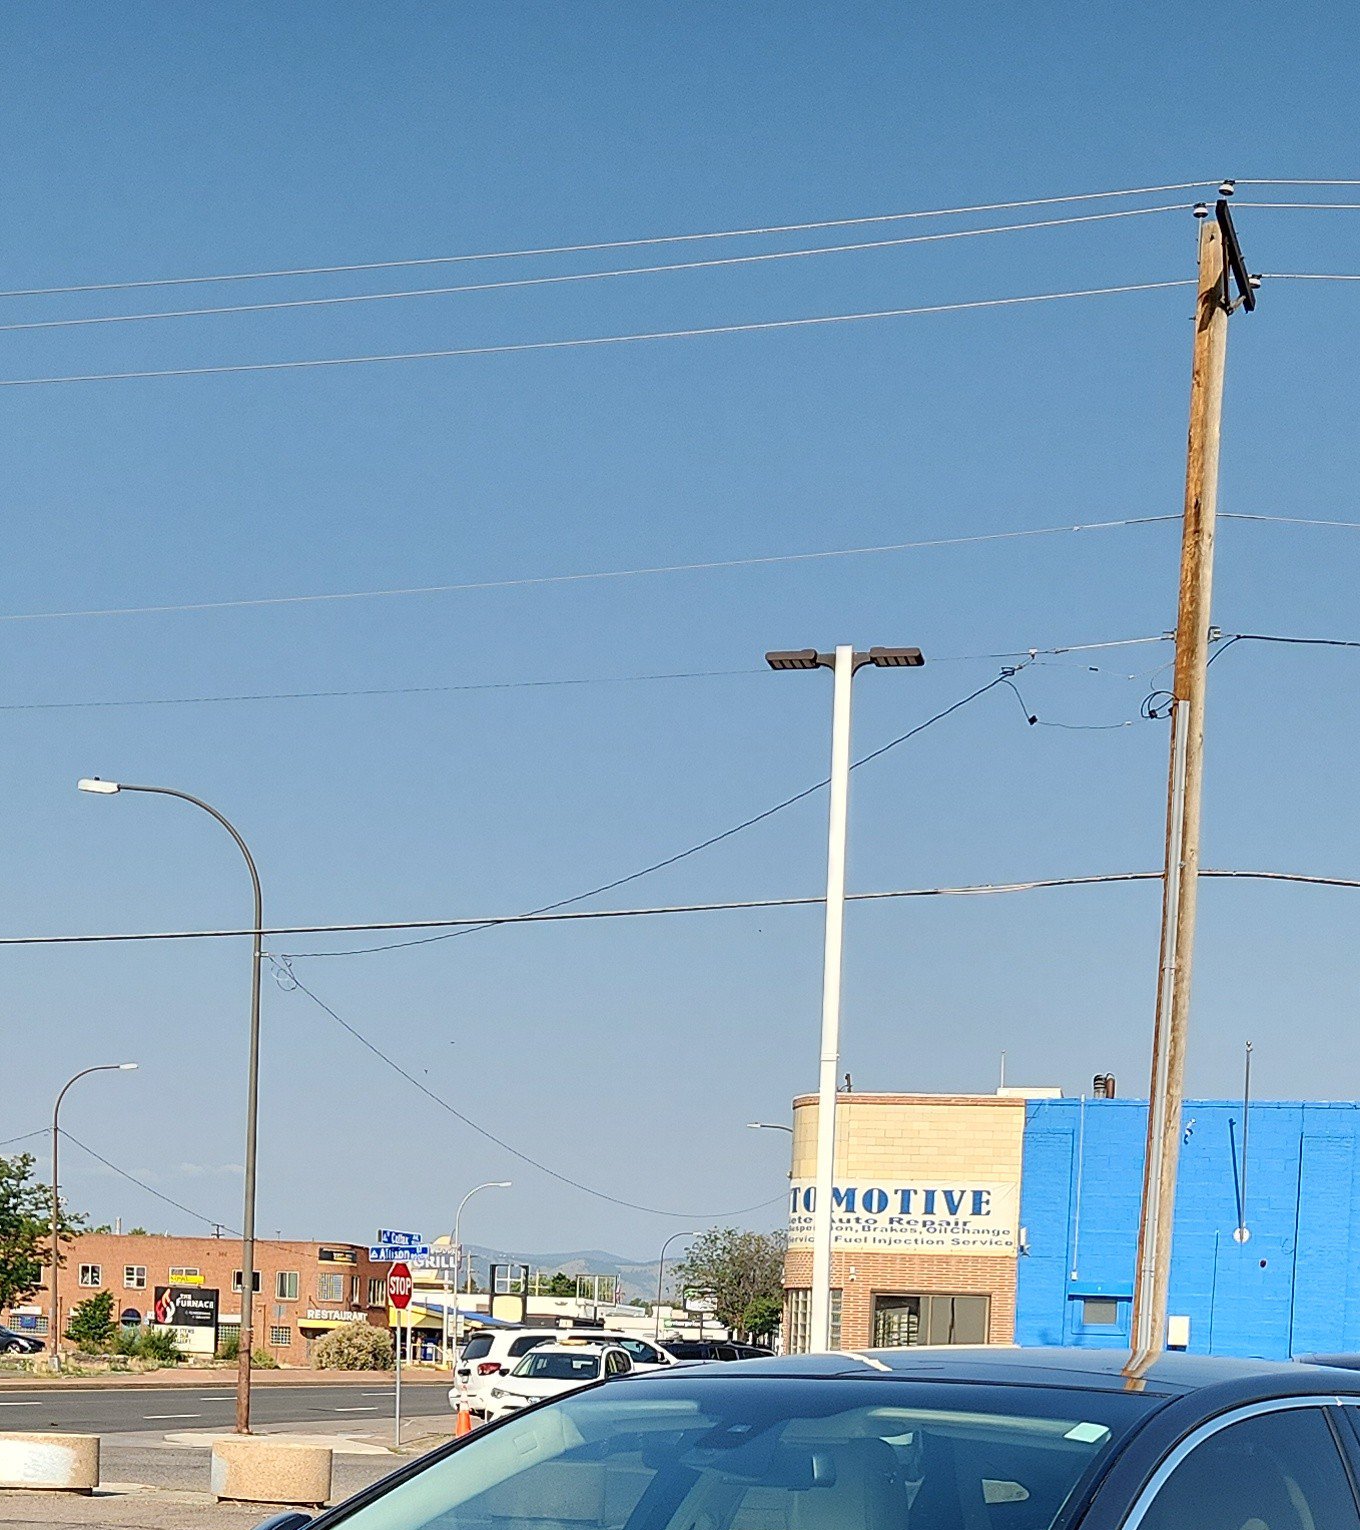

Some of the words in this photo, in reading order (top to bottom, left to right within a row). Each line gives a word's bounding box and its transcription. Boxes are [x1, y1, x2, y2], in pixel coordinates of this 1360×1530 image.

[888, 1217, 971, 1228] Repair
[834, 1235, 867, 1243] Fuel
[872, 1237, 948, 1246] Injection
[951, 1238, 1014, 1247] Service
[380, 1248, 410, 1260] Allison
[389, 1276, 411, 1295] STOP
[176, 1297, 214, 1309] FURNACE
[307, 1310, 368, 1321] RESTAURANT
